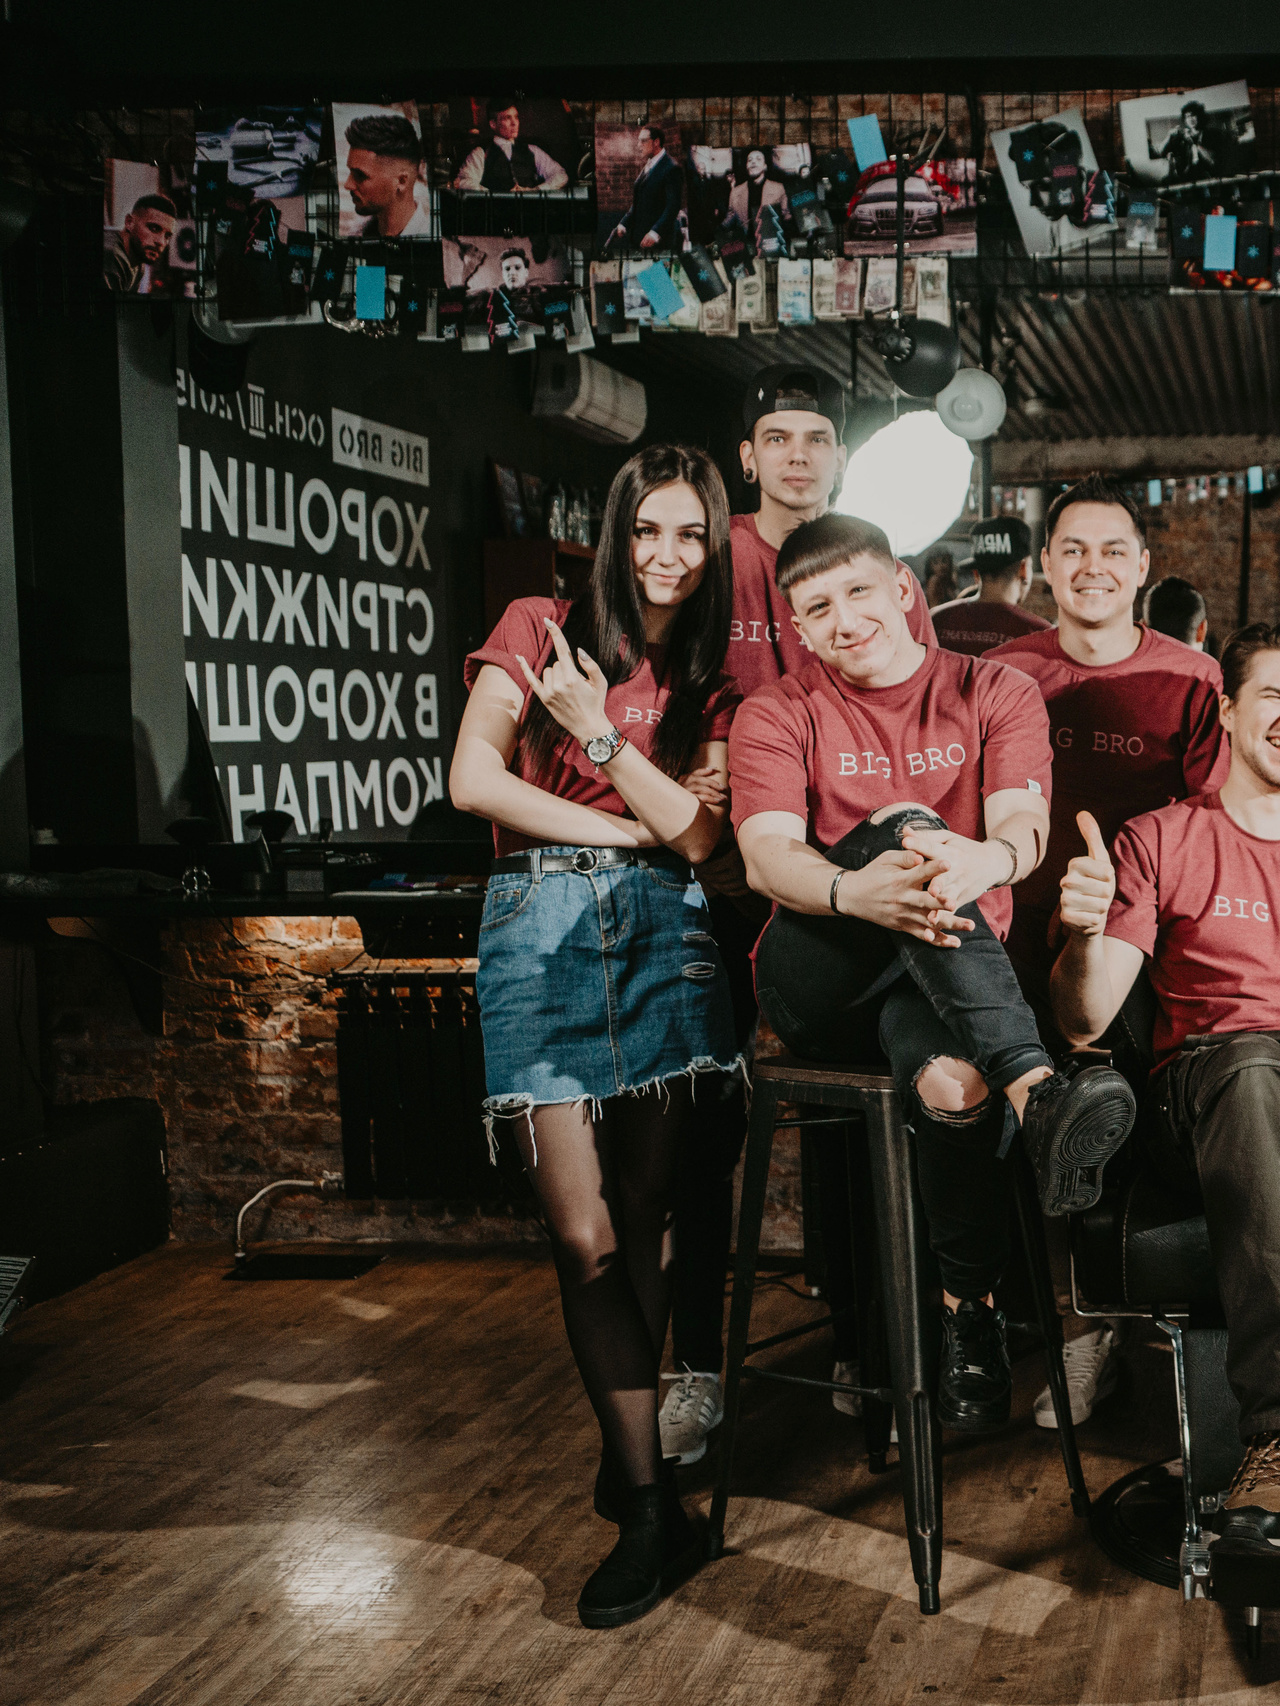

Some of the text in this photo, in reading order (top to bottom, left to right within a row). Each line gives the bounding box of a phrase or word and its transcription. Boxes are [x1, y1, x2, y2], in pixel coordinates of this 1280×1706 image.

[730, 620, 781, 643] BIG
[622, 706, 663, 725] BR
[1091, 731, 1144, 756] BRO
[838, 743, 966, 779] BIG BRO
[1212, 895, 1270, 923] BIG
